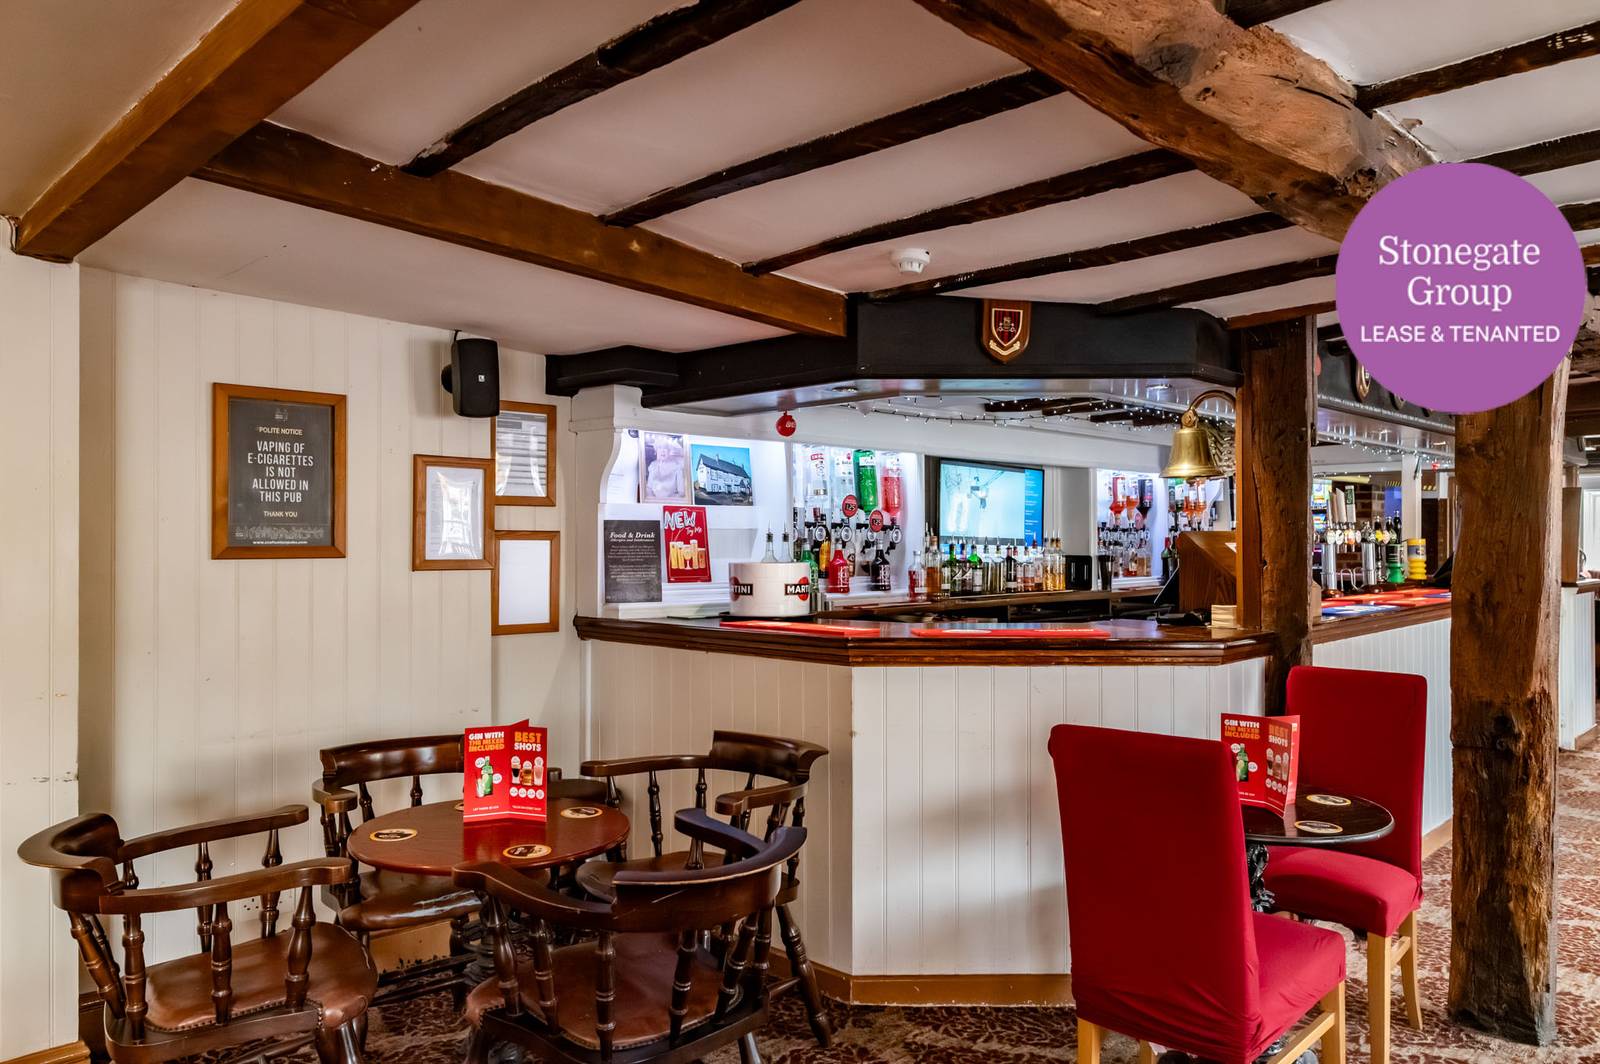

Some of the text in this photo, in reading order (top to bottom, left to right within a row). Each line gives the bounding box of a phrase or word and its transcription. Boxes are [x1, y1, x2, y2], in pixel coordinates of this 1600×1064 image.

[258, 426, 302, 435] POLITE NOTICE
[256, 441, 305, 453] VAPING OF
[248, 453, 313, 466] E-CIGARETTES
[266, 466, 296, 478] IS NOT
[252, 478, 308, 491] ALLOWED IN
[260, 491, 302, 503] THIS PUB
[664, 510, 696, 531] NEW
[1239, 720, 1259, 728] WITH
[514, 732, 542, 743] BEST
[1224, 731, 1260, 740] INCLUDED
[469, 744, 504, 752] INCLUDED
[514, 742, 542, 752] SHOTS
